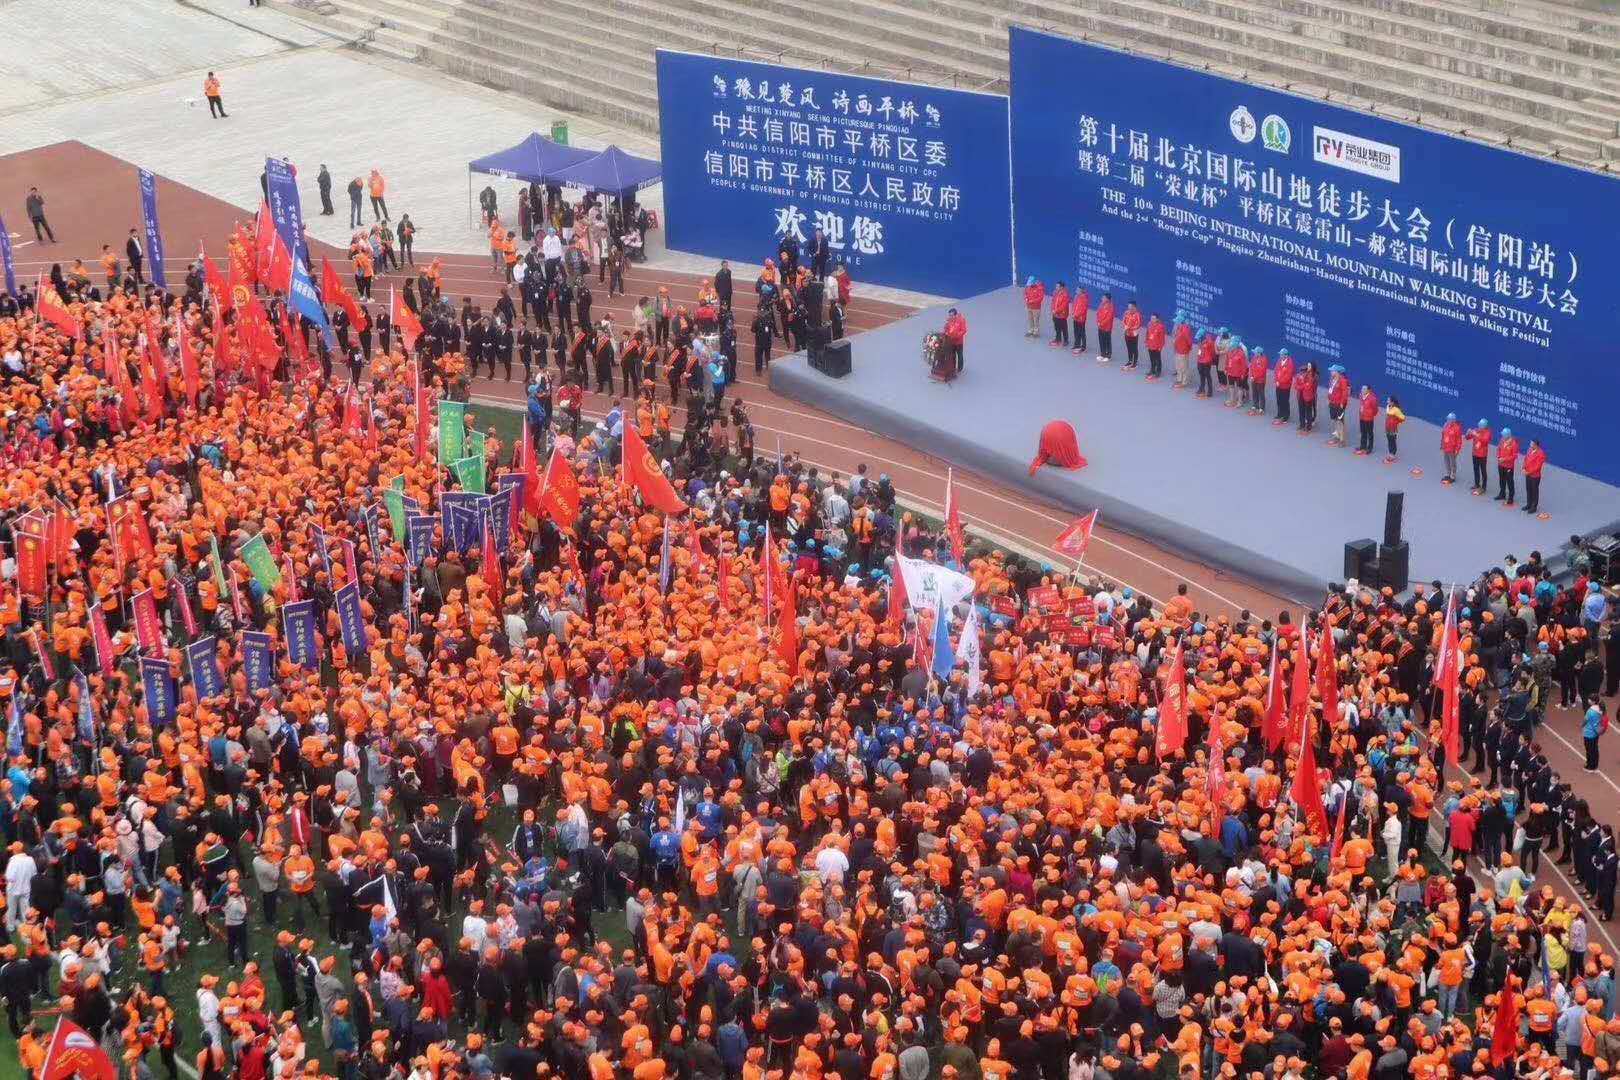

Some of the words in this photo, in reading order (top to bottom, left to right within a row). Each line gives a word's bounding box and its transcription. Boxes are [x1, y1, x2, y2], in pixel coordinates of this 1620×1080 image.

[734, 78, 820, 110] 豫见楚风
[832, 90, 919, 124] 诗画平桥
[774, 109, 801, 119] XINYANG
[807, 113, 830, 123] SEEING
[713, 111, 946, 166] 中共信阳市平桥区委
[722, 140, 757, 150] PINGQIAO
[762, 146, 797, 156] DISTRICT
[802, 151, 843, 163] COMMITTEE
[863, 160, 894, 171] XINYANG
[900, 166, 918, 174] CITY
[924, 169, 936, 177] CPC
[704, 151, 960, 210] 信阳市平桥区人民政府
[711, 178, 745, 189] PEOPLE'S
[751, 185, 794, 196] GOVERNMENT
[814, 193, 849, 205] PINGQIAO
[855, 200, 890, 211] DISTRICT
[897, 207, 929, 217] XINYANG
[934, 212, 952, 220] CITY
[775, 205, 884, 255] 欢迎您
[1101, 187, 1126, 204] THE
[1135, 197, 1153, 209] 10th
[1161, 204, 1207, 227] BEIJING
[1211, 219, 1322, 262] INTERNATIONAL
[1326, 254, 1404, 287] MOUNTAIN
[1409, 278, 1477, 309] WALKING
[1482, 300, 1552, 333] FESTIVAL
[1102, 204, 1118, 215] And
[1121, 209, 1133, 219] the
[1217, 237, 1255, 255] Pingqiao
[1358, 280, 1416, 305] International
[1421, 299, 1465, 320] Mountain
[1469, 314, 1508, 335] Walking
[1513, 327, 1549, 347] Festival
